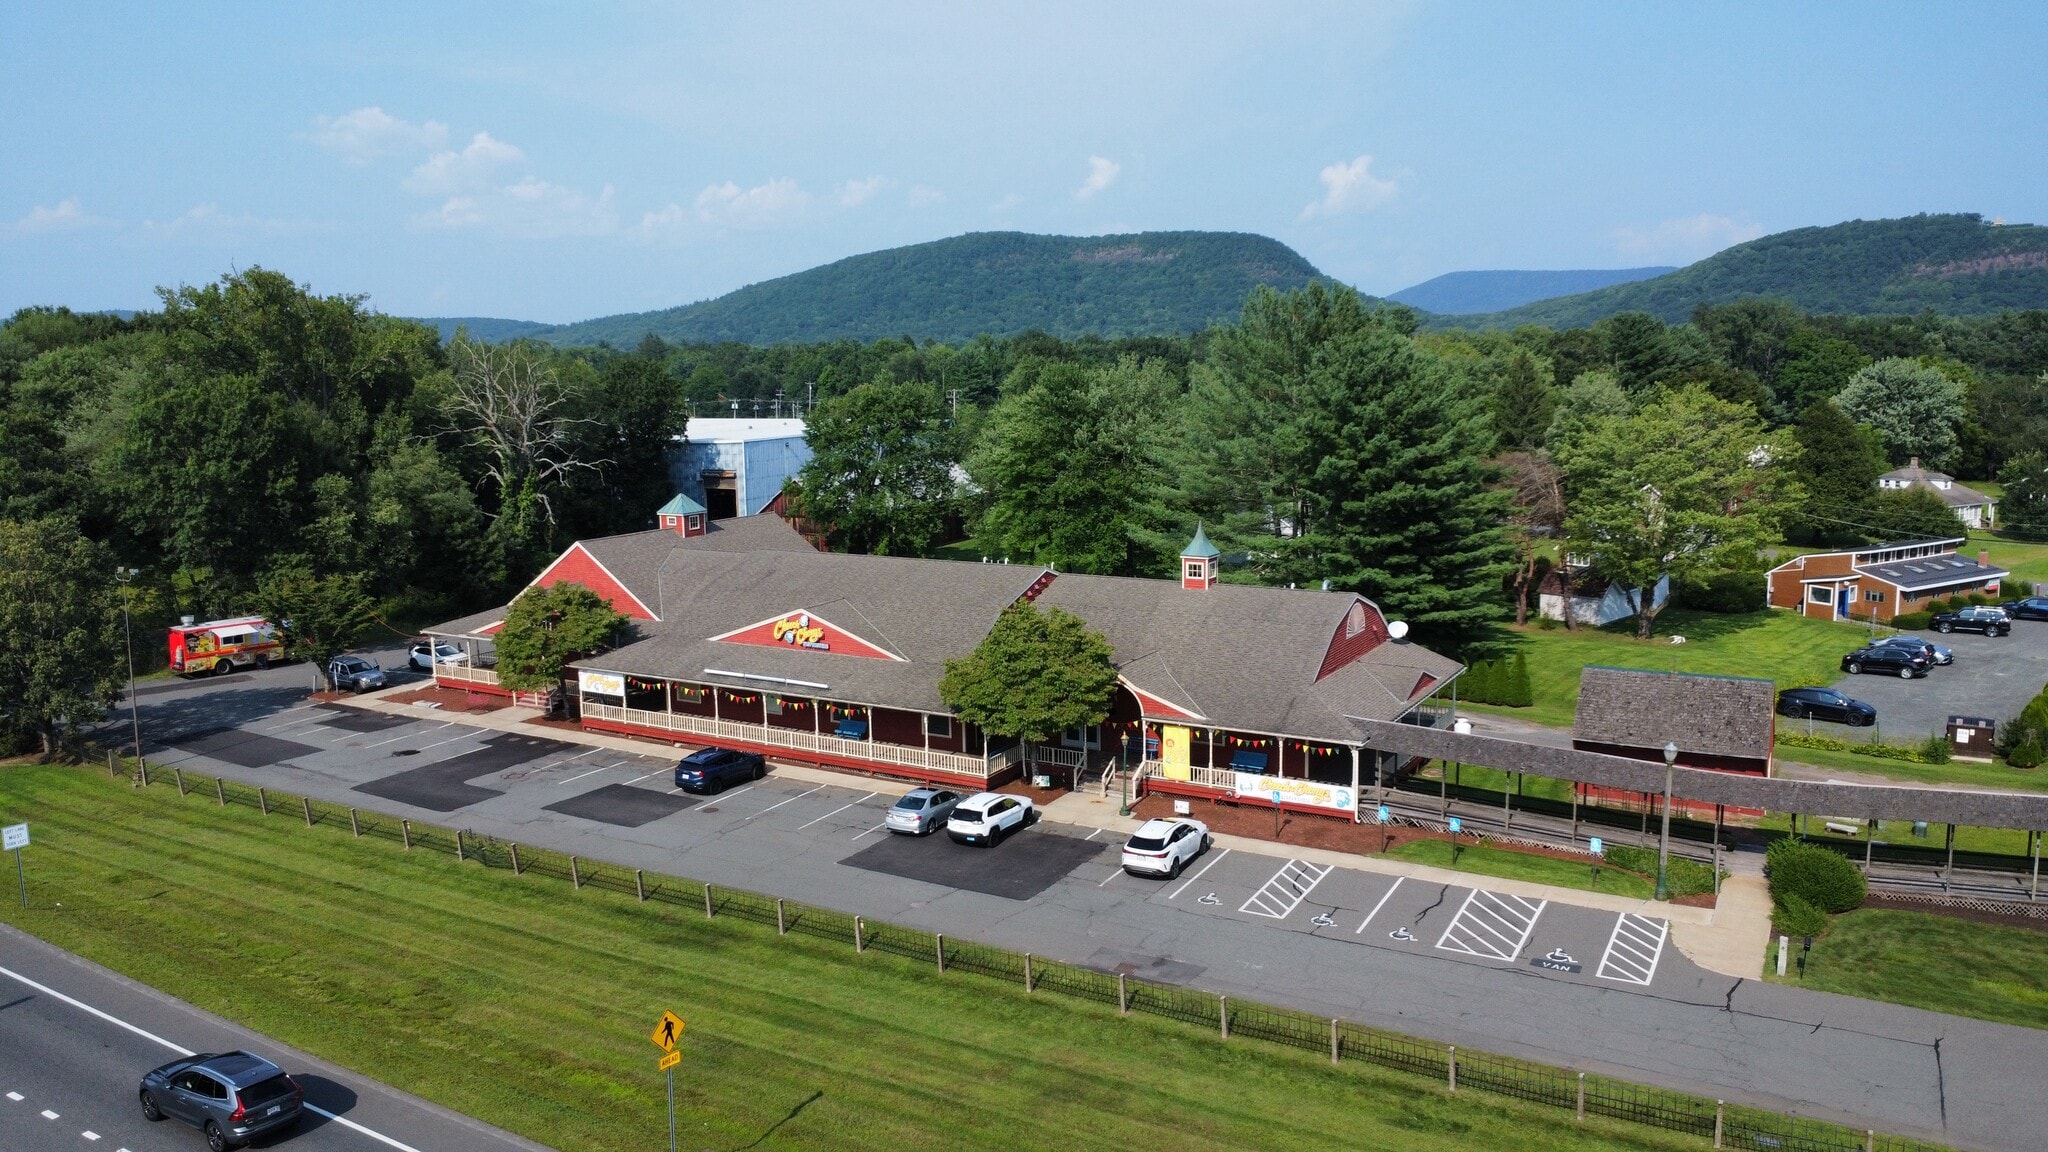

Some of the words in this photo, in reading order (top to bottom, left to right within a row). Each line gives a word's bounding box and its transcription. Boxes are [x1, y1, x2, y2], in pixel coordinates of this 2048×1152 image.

[9, 832, 22, 840] MUST
[1543, 961, 1570, 971] VAN
[661, 1053, 679, 1066] AHEAD
